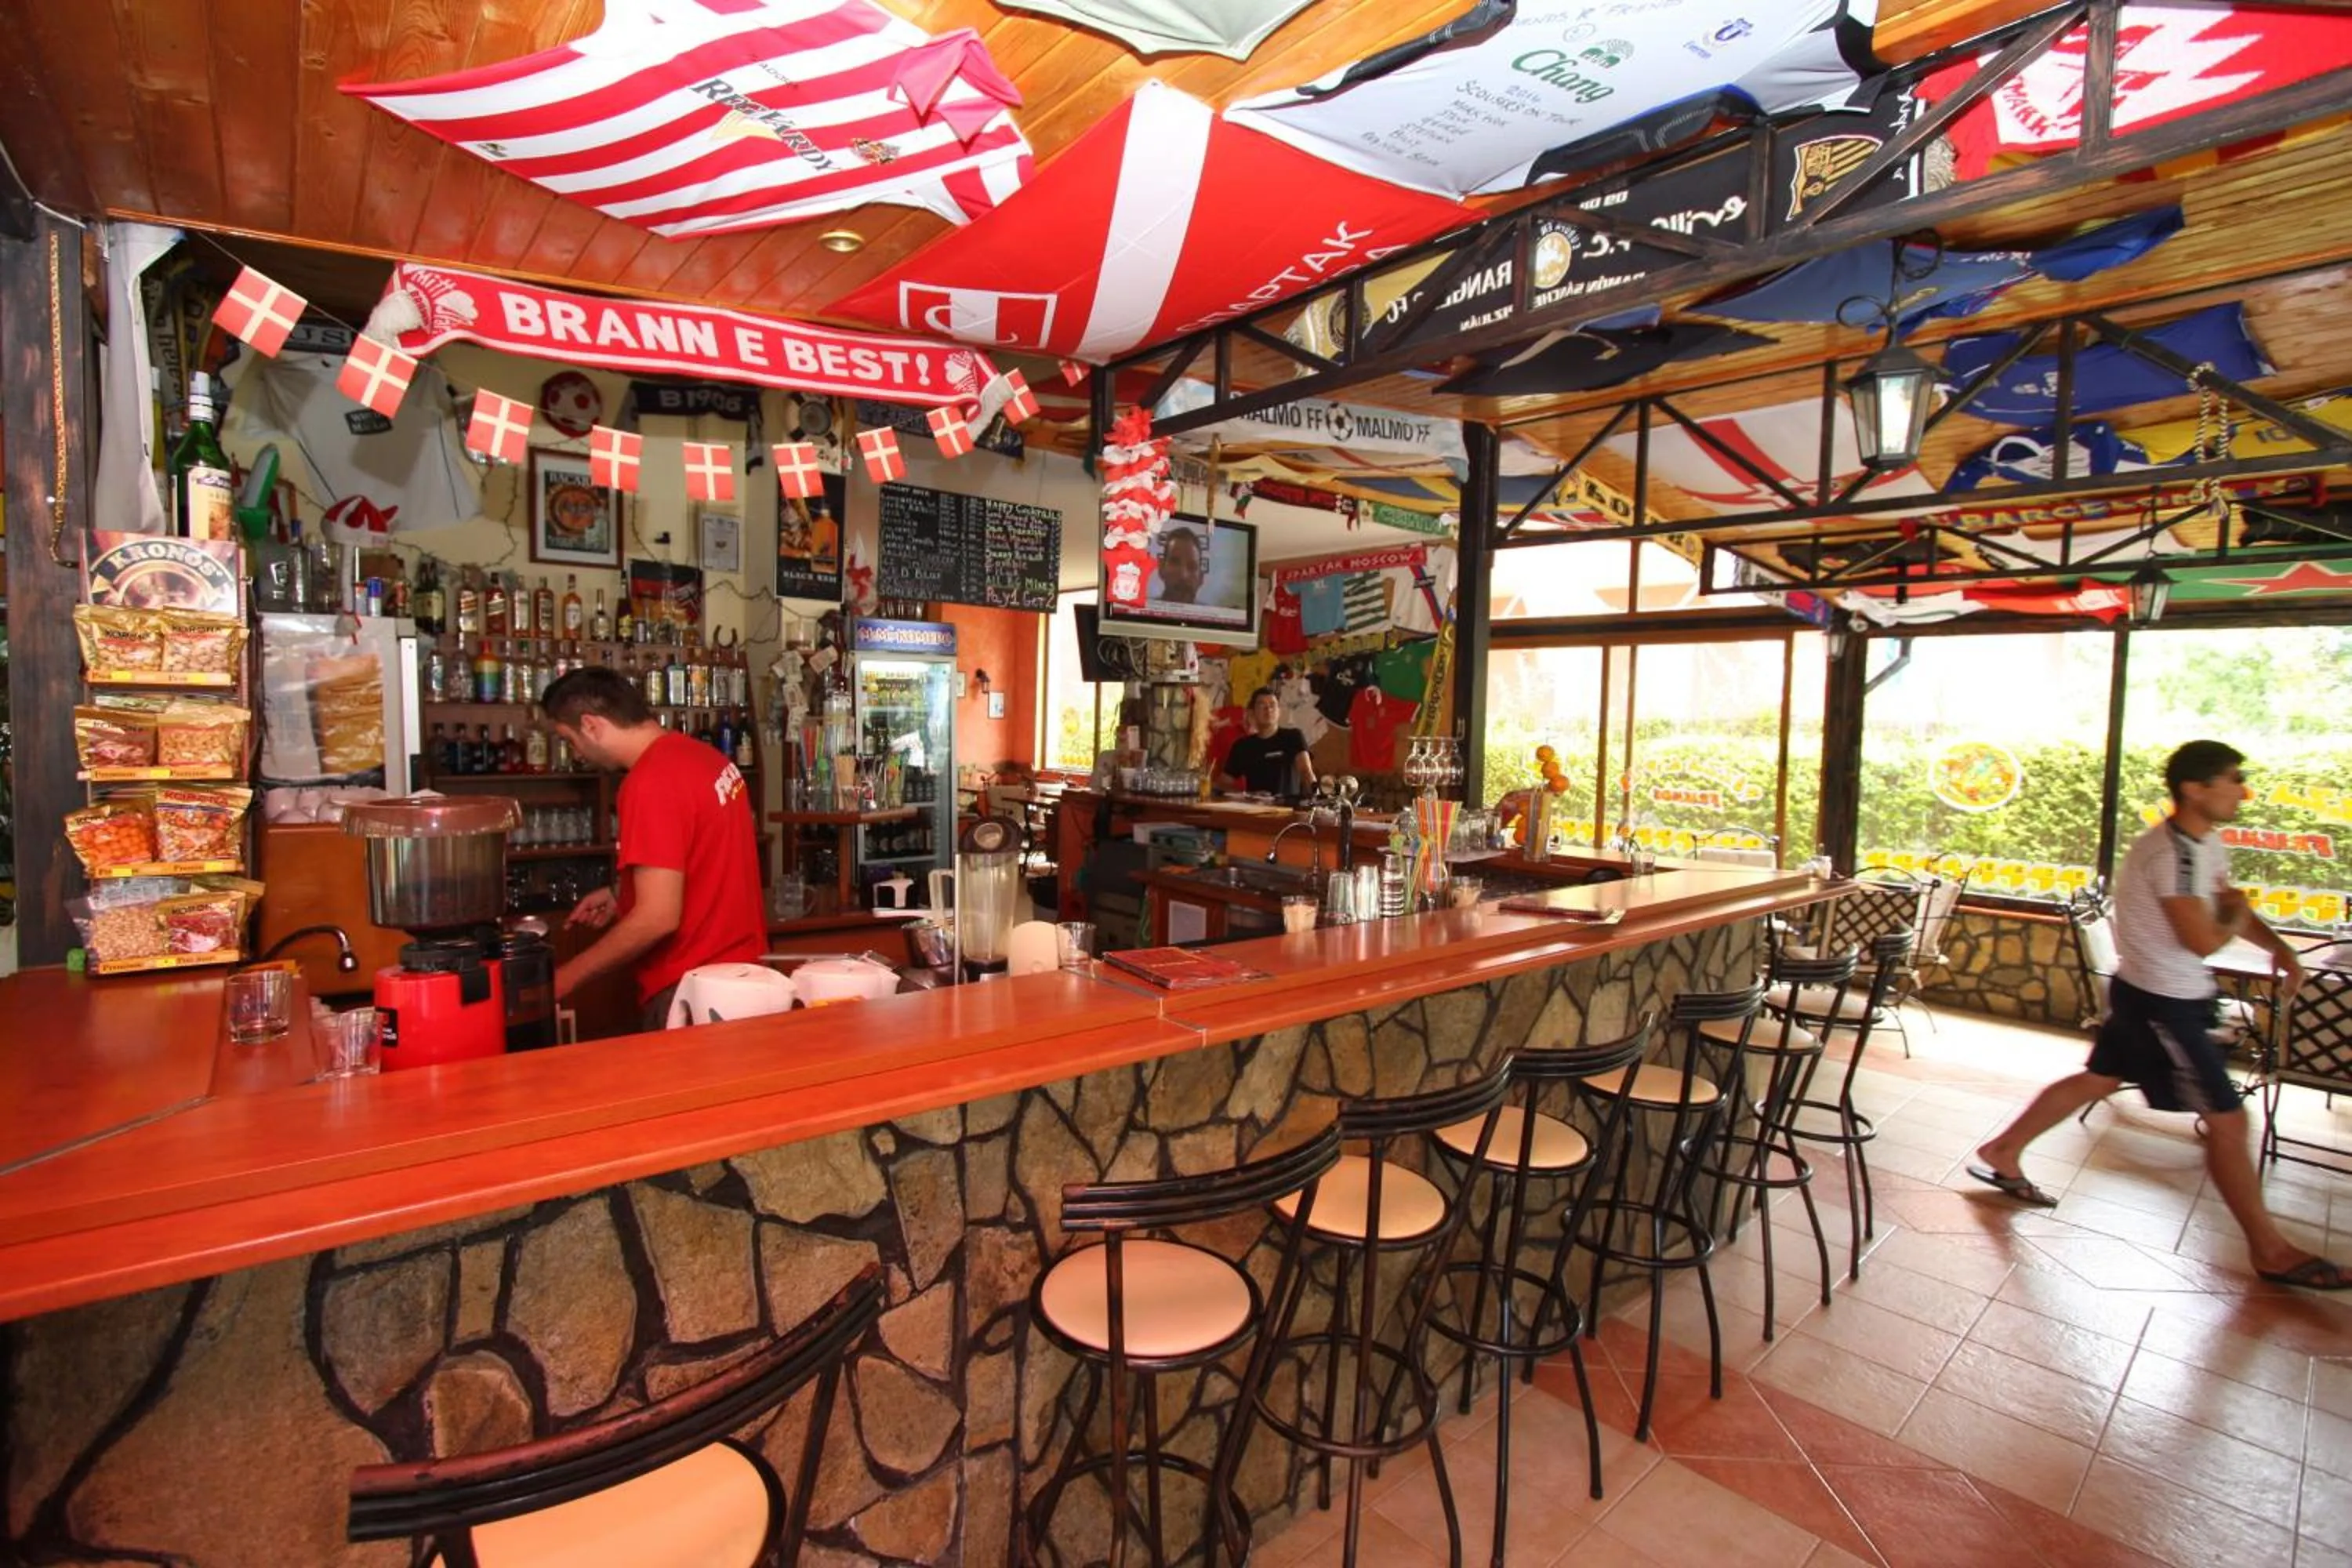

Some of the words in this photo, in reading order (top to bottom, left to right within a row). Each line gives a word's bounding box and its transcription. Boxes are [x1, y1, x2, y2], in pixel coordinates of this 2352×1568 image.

[1511, 49, 1615, 103] Chang
[499, 291, 719, 359] BRANN
[734, 326, 769, 367] E
[781, 337, 931, 387] BEST!
[1306, 407, 1323, 430] FF
[1356, 416, 1414, 441] MALMÖ
[107, 543, 217, 577] KRONOS
